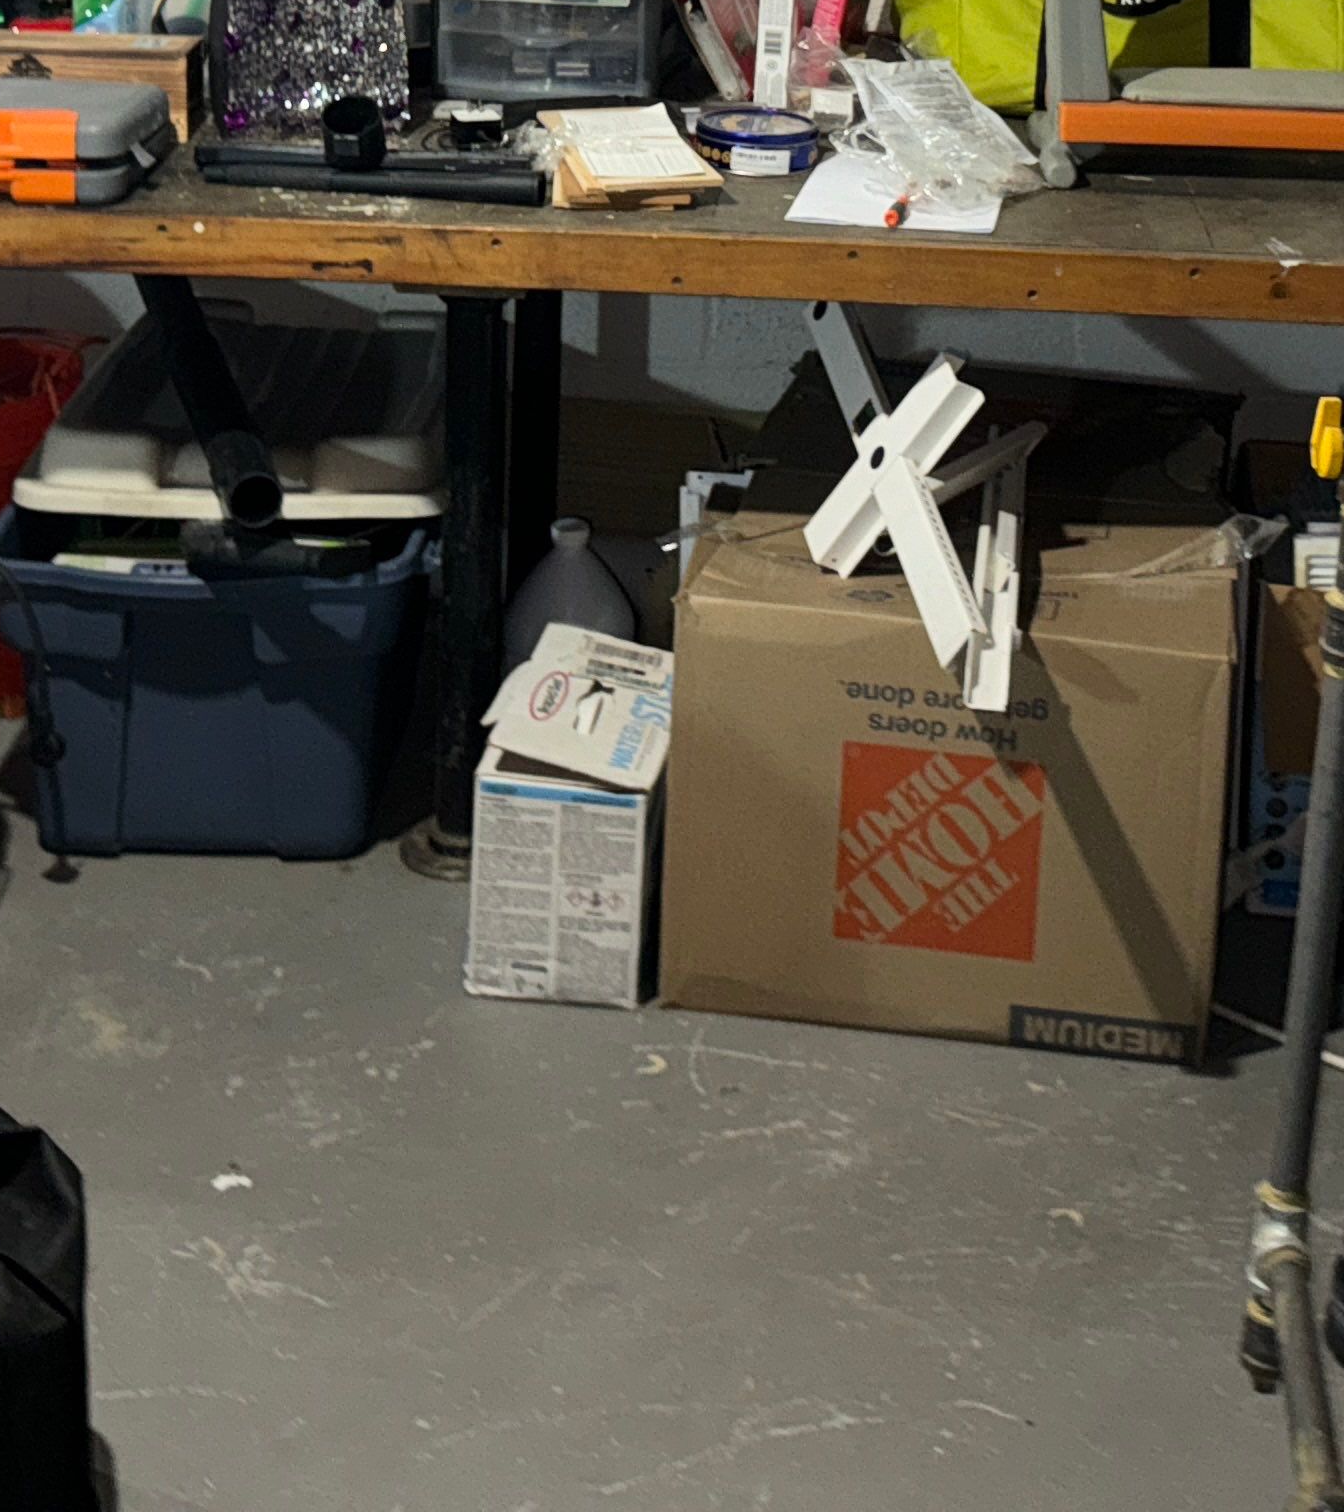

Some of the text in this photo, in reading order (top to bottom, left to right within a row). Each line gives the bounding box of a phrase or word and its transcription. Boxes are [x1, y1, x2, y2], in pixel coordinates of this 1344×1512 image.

[868, 713, 1019, 751] How doers
[838, 753, 965, 871] DEPOT
[836, 761, 1042, 941] HOME
[932, 856, 1020, 933] THE
[1021, 1011, 1184, 1059] MEDIUM
